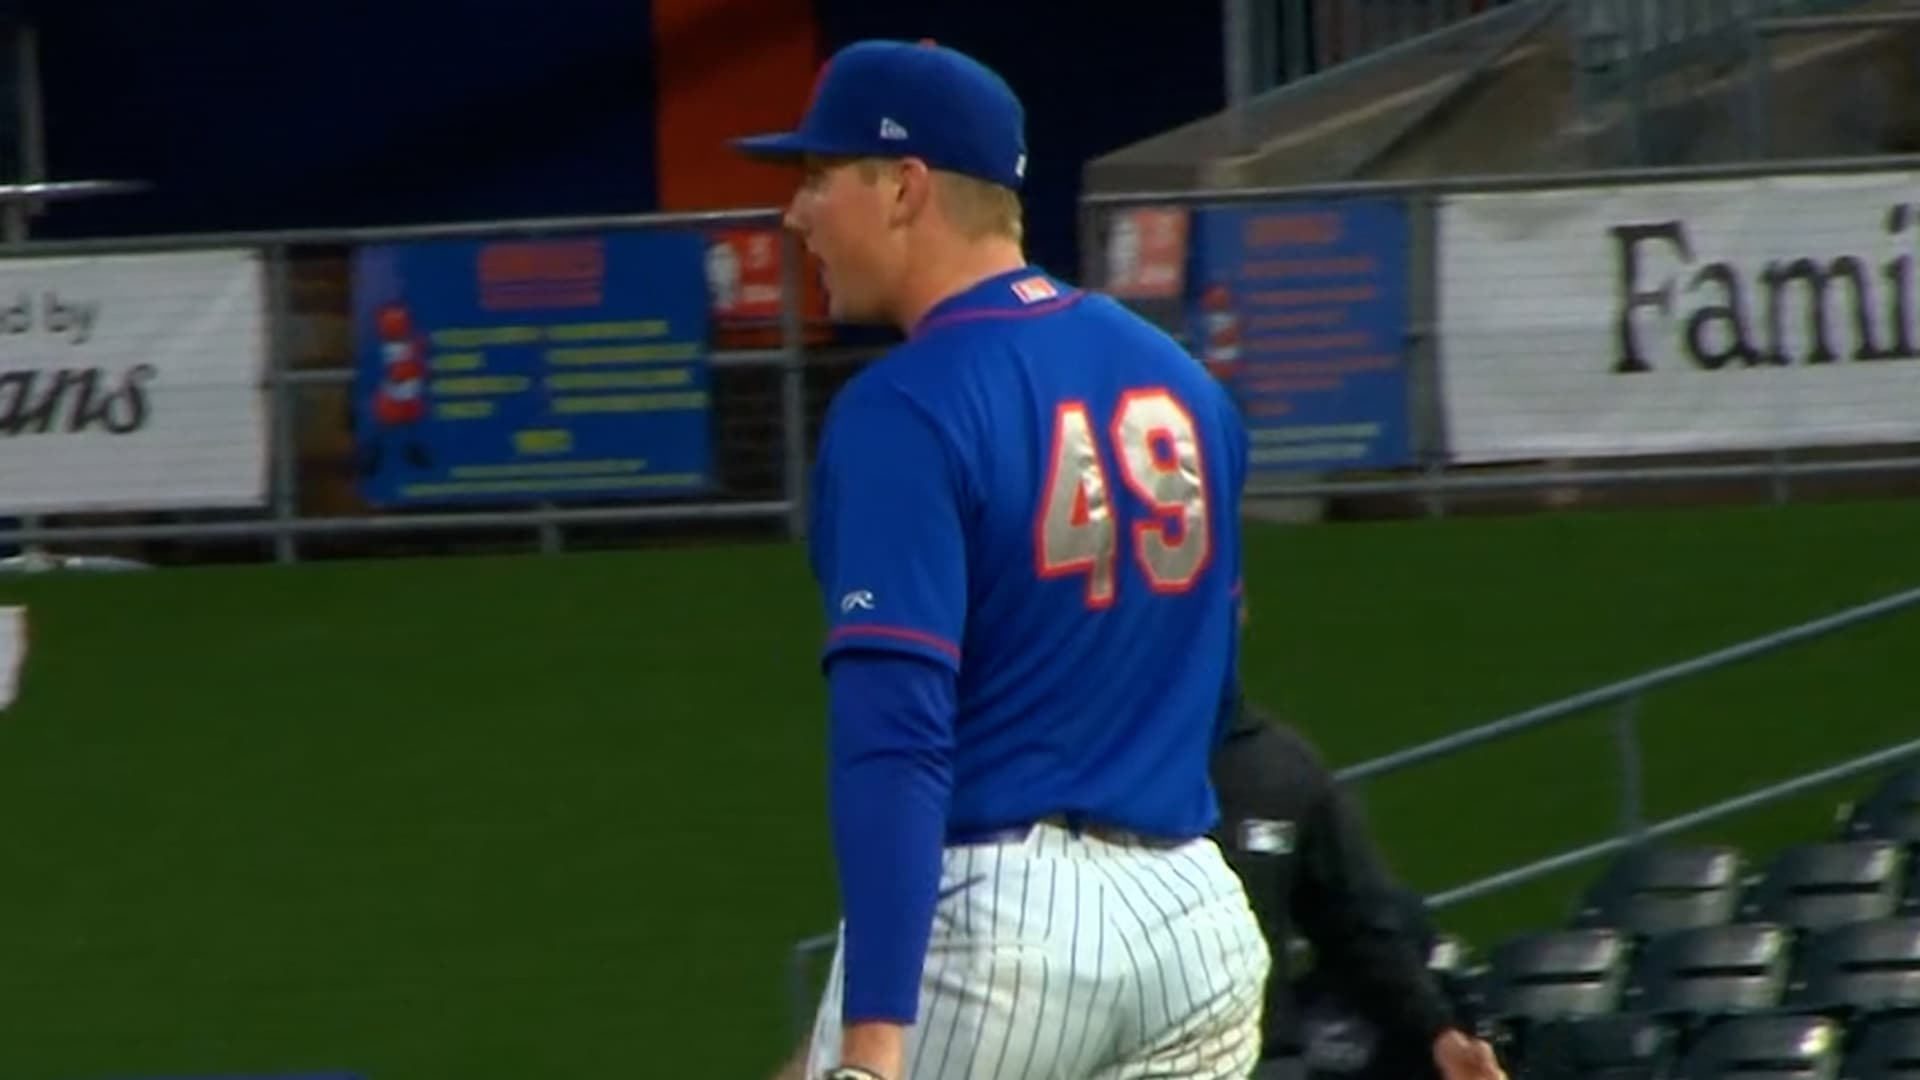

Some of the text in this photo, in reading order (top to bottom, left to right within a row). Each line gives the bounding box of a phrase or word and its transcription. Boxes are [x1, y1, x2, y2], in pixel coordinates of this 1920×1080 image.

[43, 290, 99, 346] by
[1607, 202, 1919, 374] Fami
[1033, 386, 1214, 610] 49
